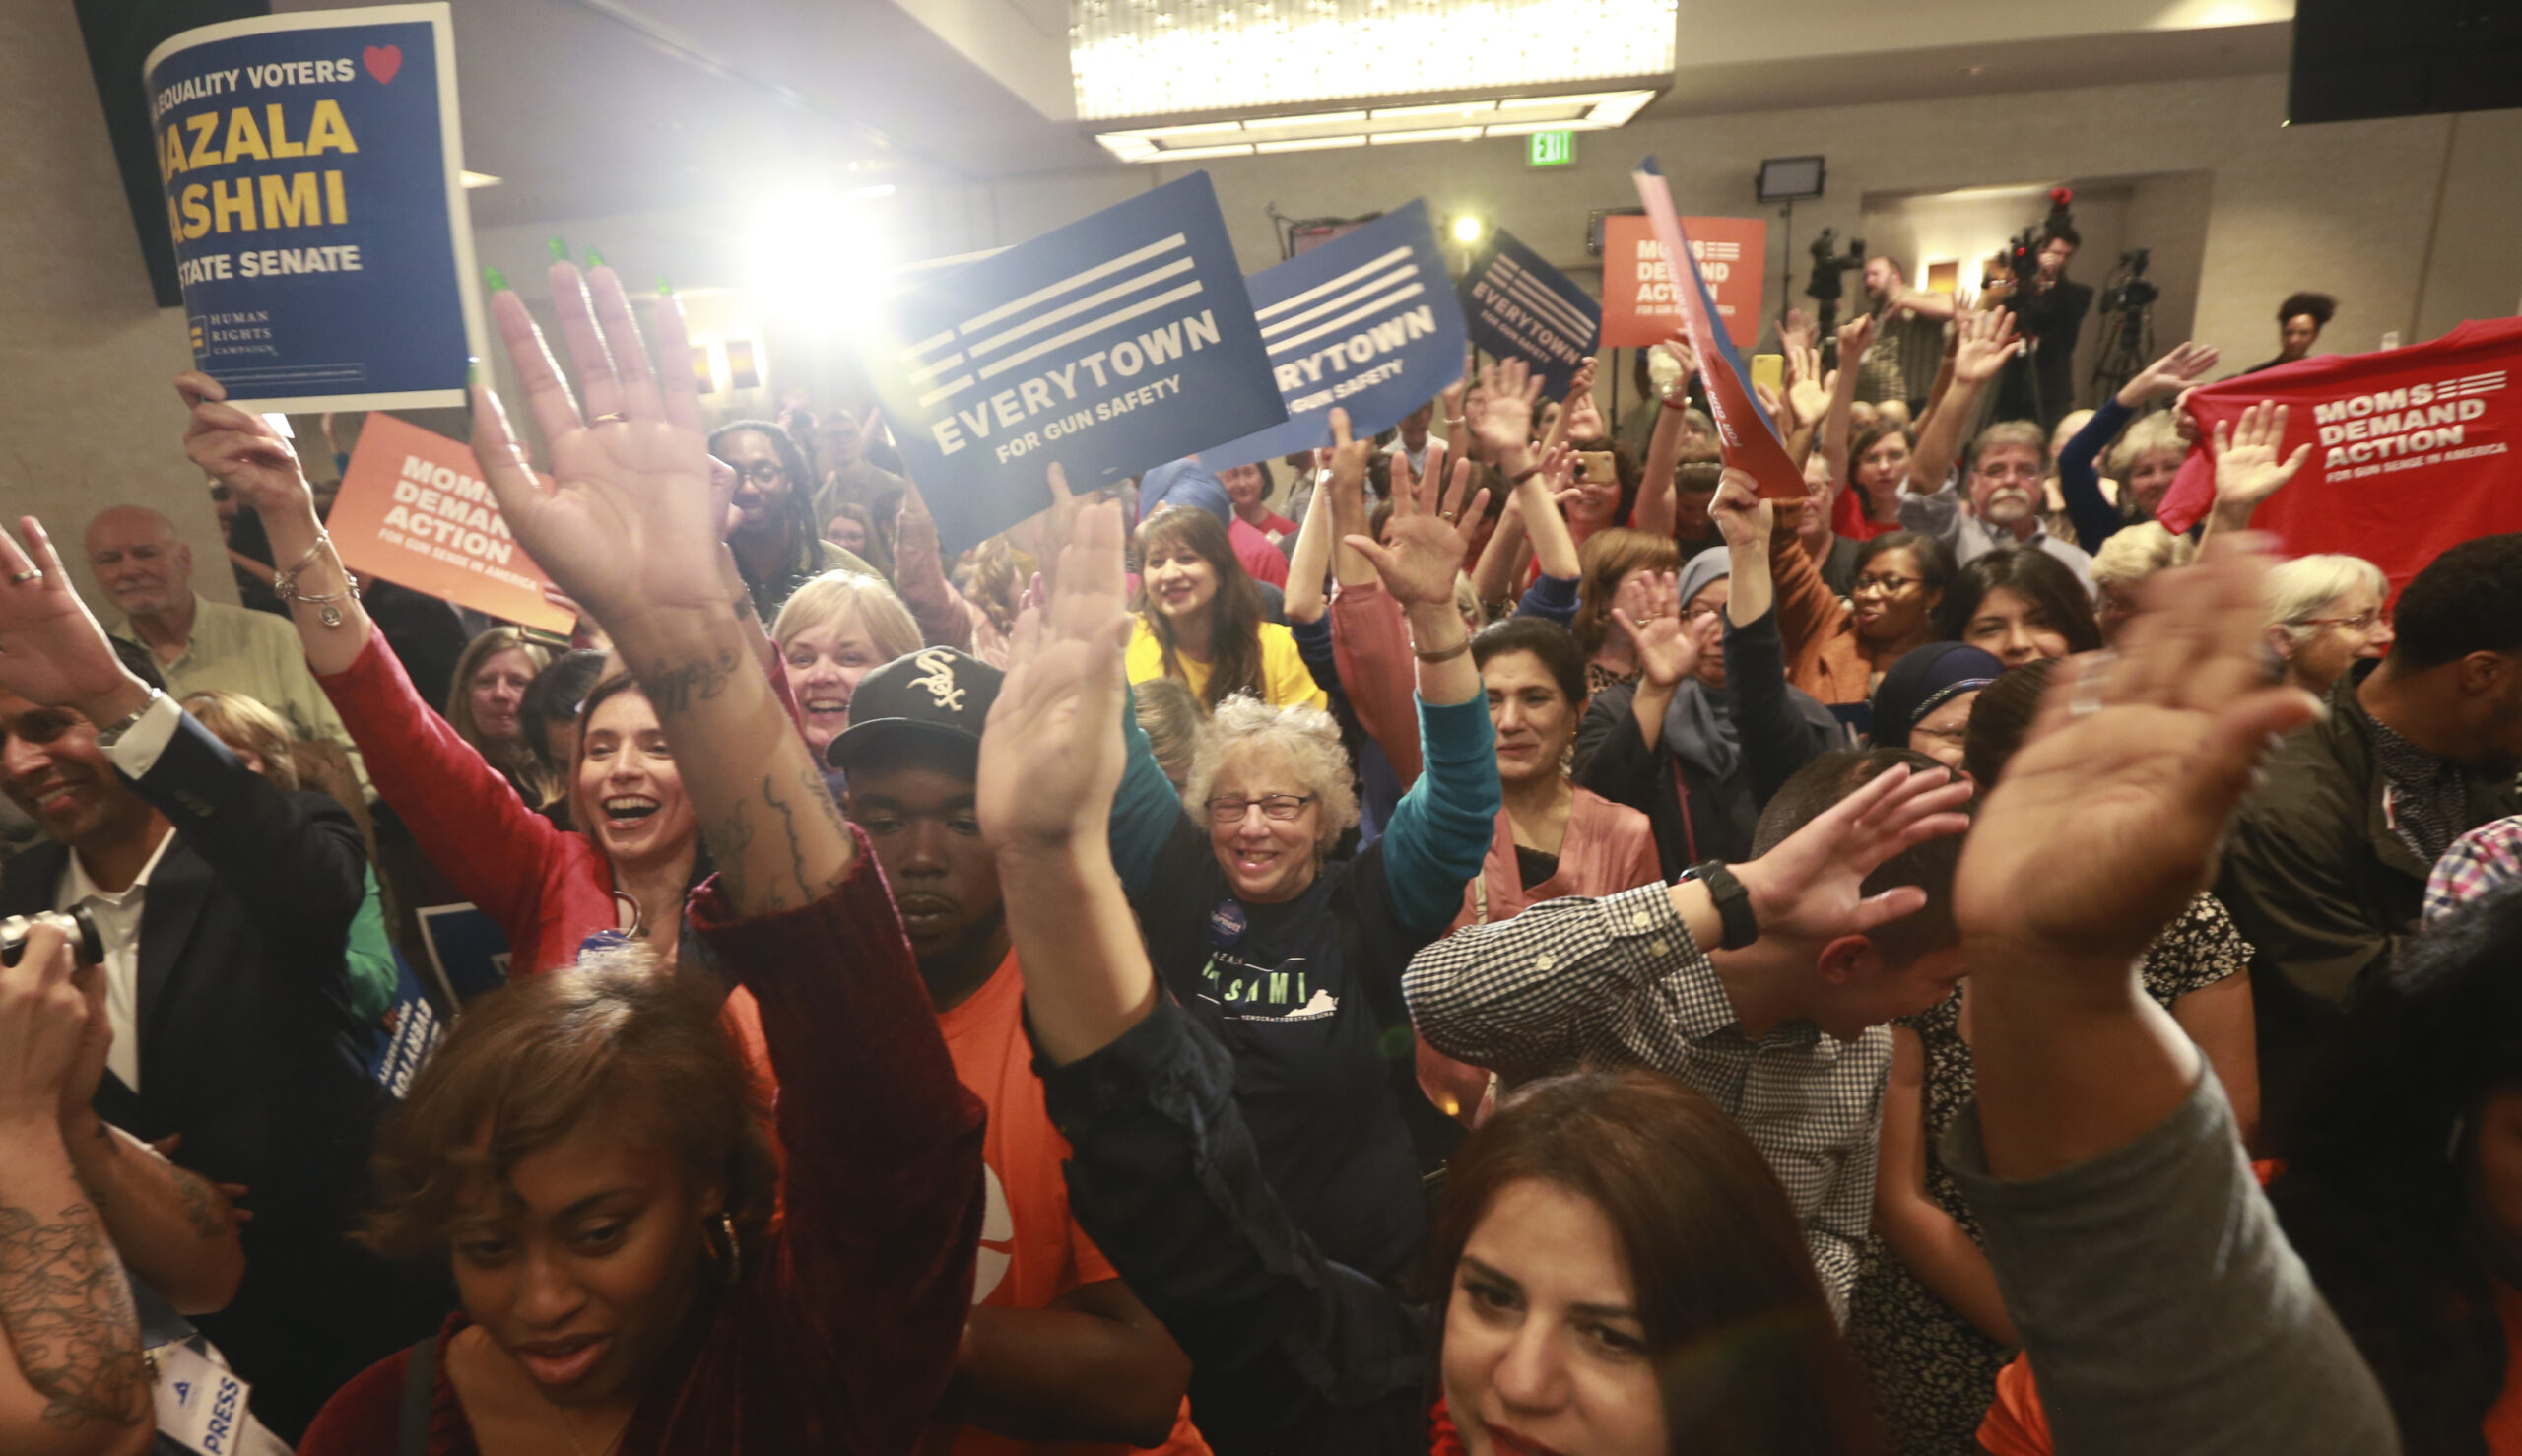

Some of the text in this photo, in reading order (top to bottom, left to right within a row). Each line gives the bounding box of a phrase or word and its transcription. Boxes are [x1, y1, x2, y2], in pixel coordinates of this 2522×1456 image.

[158, 58, 355, 114] EQUALITY VOTERS
[1534, 131, 1569, 163] EXIT
[239, 245, 363, 279] SENATE
[1637, 261, 1730, 283] DEND
[209, 311, 269, 325] HUMAN
[211, 328, 272, 342] RIGHTS
[1472, 281, 1581, 364] EVERYTOWN
[931, 309, 1222, 456] EVERYTOWN
[1333, 358, 1404, 400] SAFETY
[995, 374, 1180, 465] FOR GUN SAFETY
[2313, 383, 2435, 425] MOMS
[2319, 398, 2486, 446] DEMAND
[2324, 425, 2464, 469] ACTION
[2325, 442, 2508, 484] FOR GUN SENSE IN AMERICA
[383, 505, 513, 565] ACTION
[378, 527, 537, 591] FOR GUN SENSE IN AMERICA
[203, 1376, 239, 1456] PRESS
